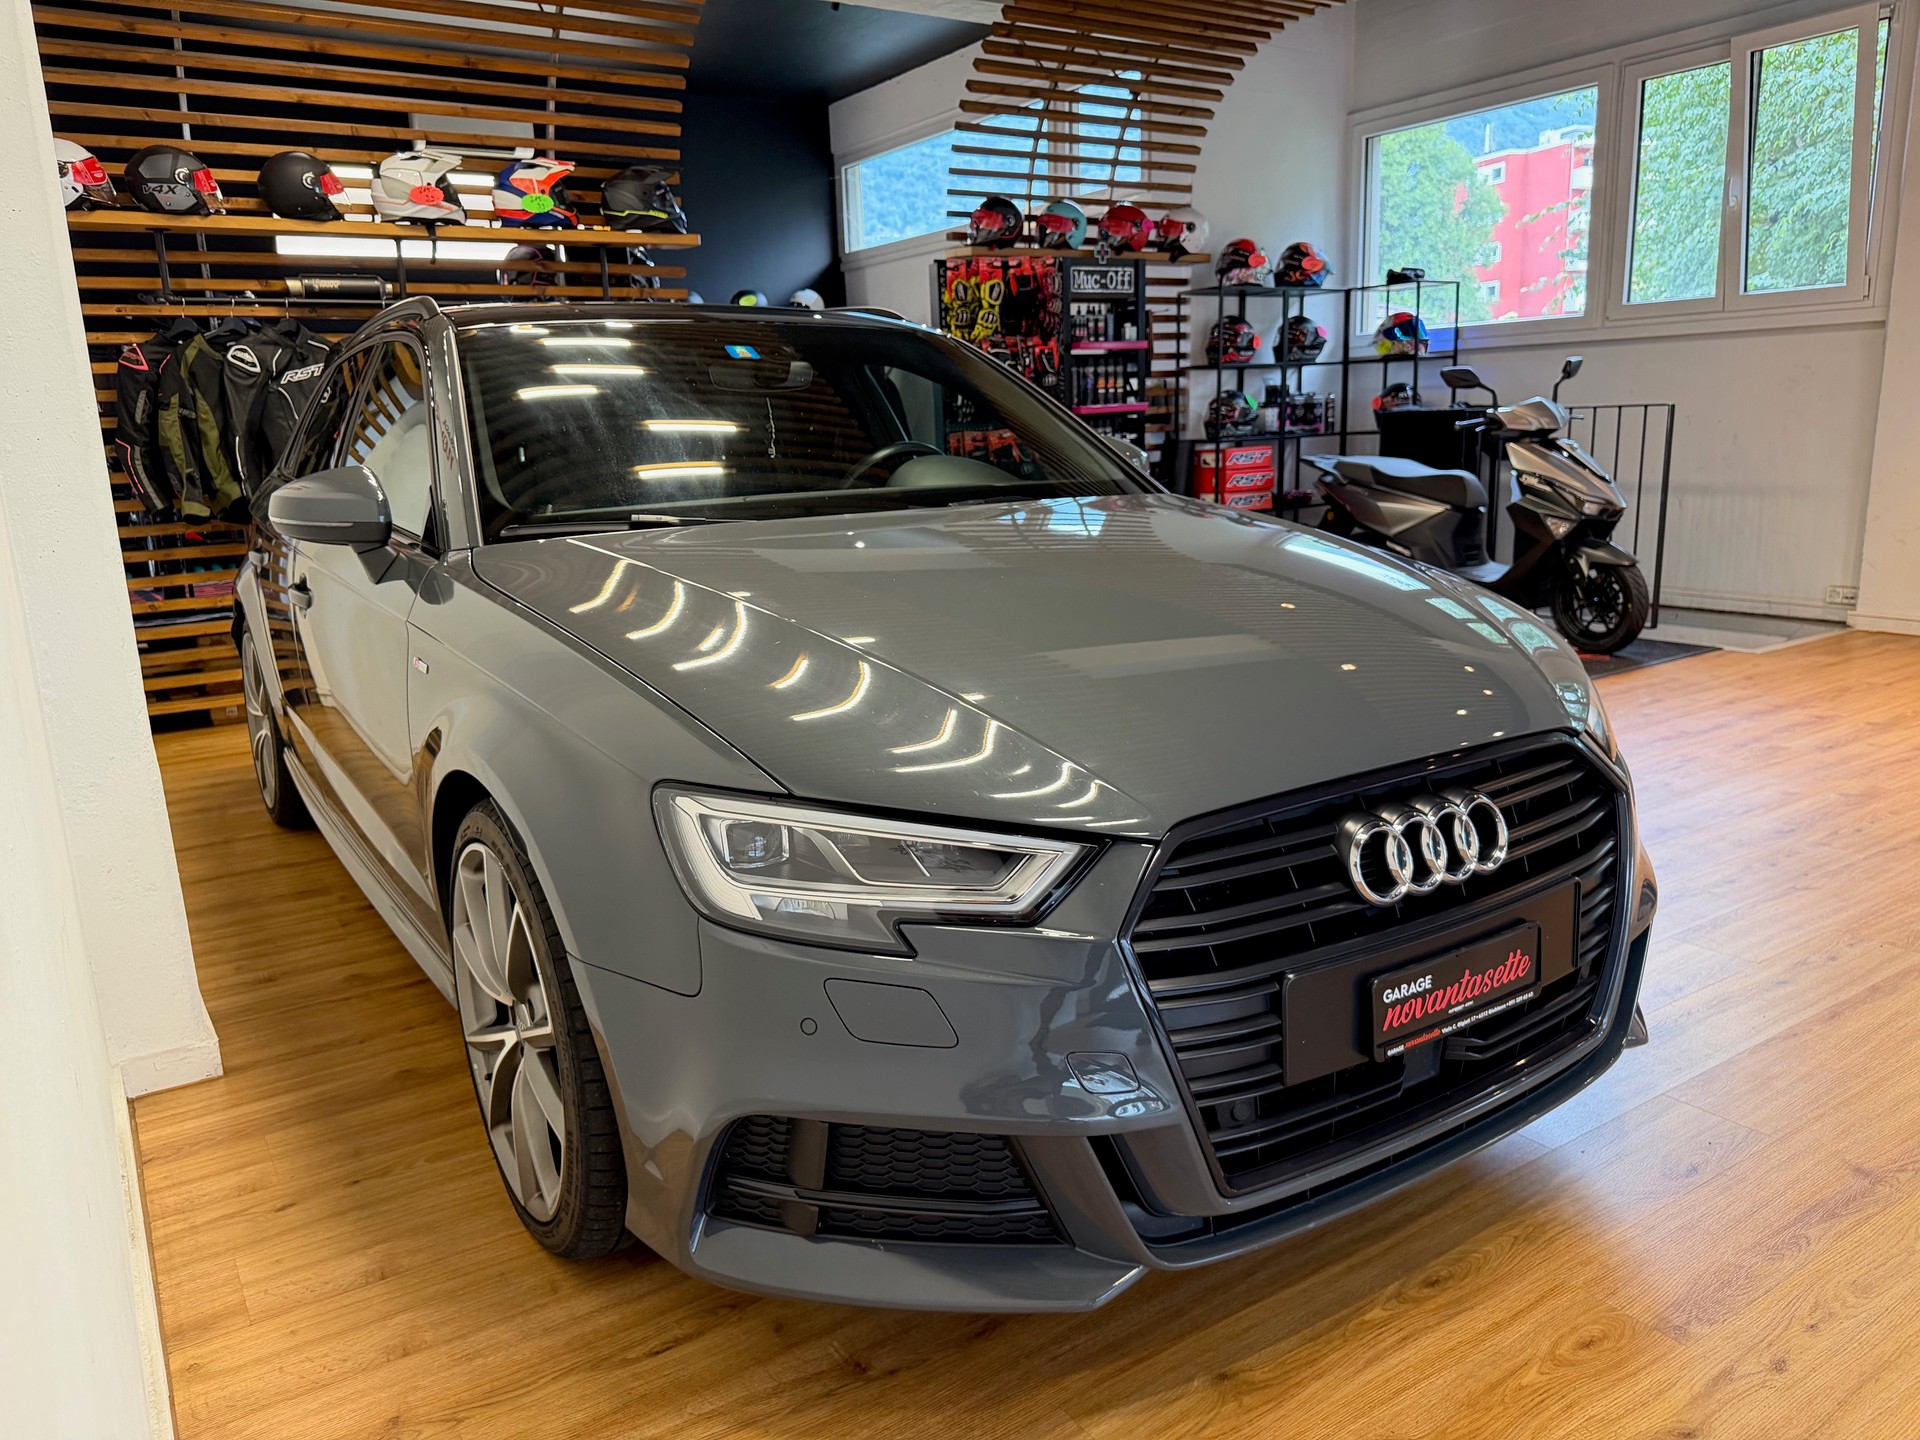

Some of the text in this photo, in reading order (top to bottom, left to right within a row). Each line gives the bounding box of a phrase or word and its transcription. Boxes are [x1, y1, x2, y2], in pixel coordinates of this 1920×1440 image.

[1073, 270, 1131, 289] Muc-Off
[280, 363, 324, 385] RST
[1226, 450, 1272, 466] RST
[1226, 471, 1274, 488] RST
[1226, 493, 1272, 509] RST
[1382, 949, 1531, 1032] novantasette
[1383, 975, 1432, 1003] GARAGE
